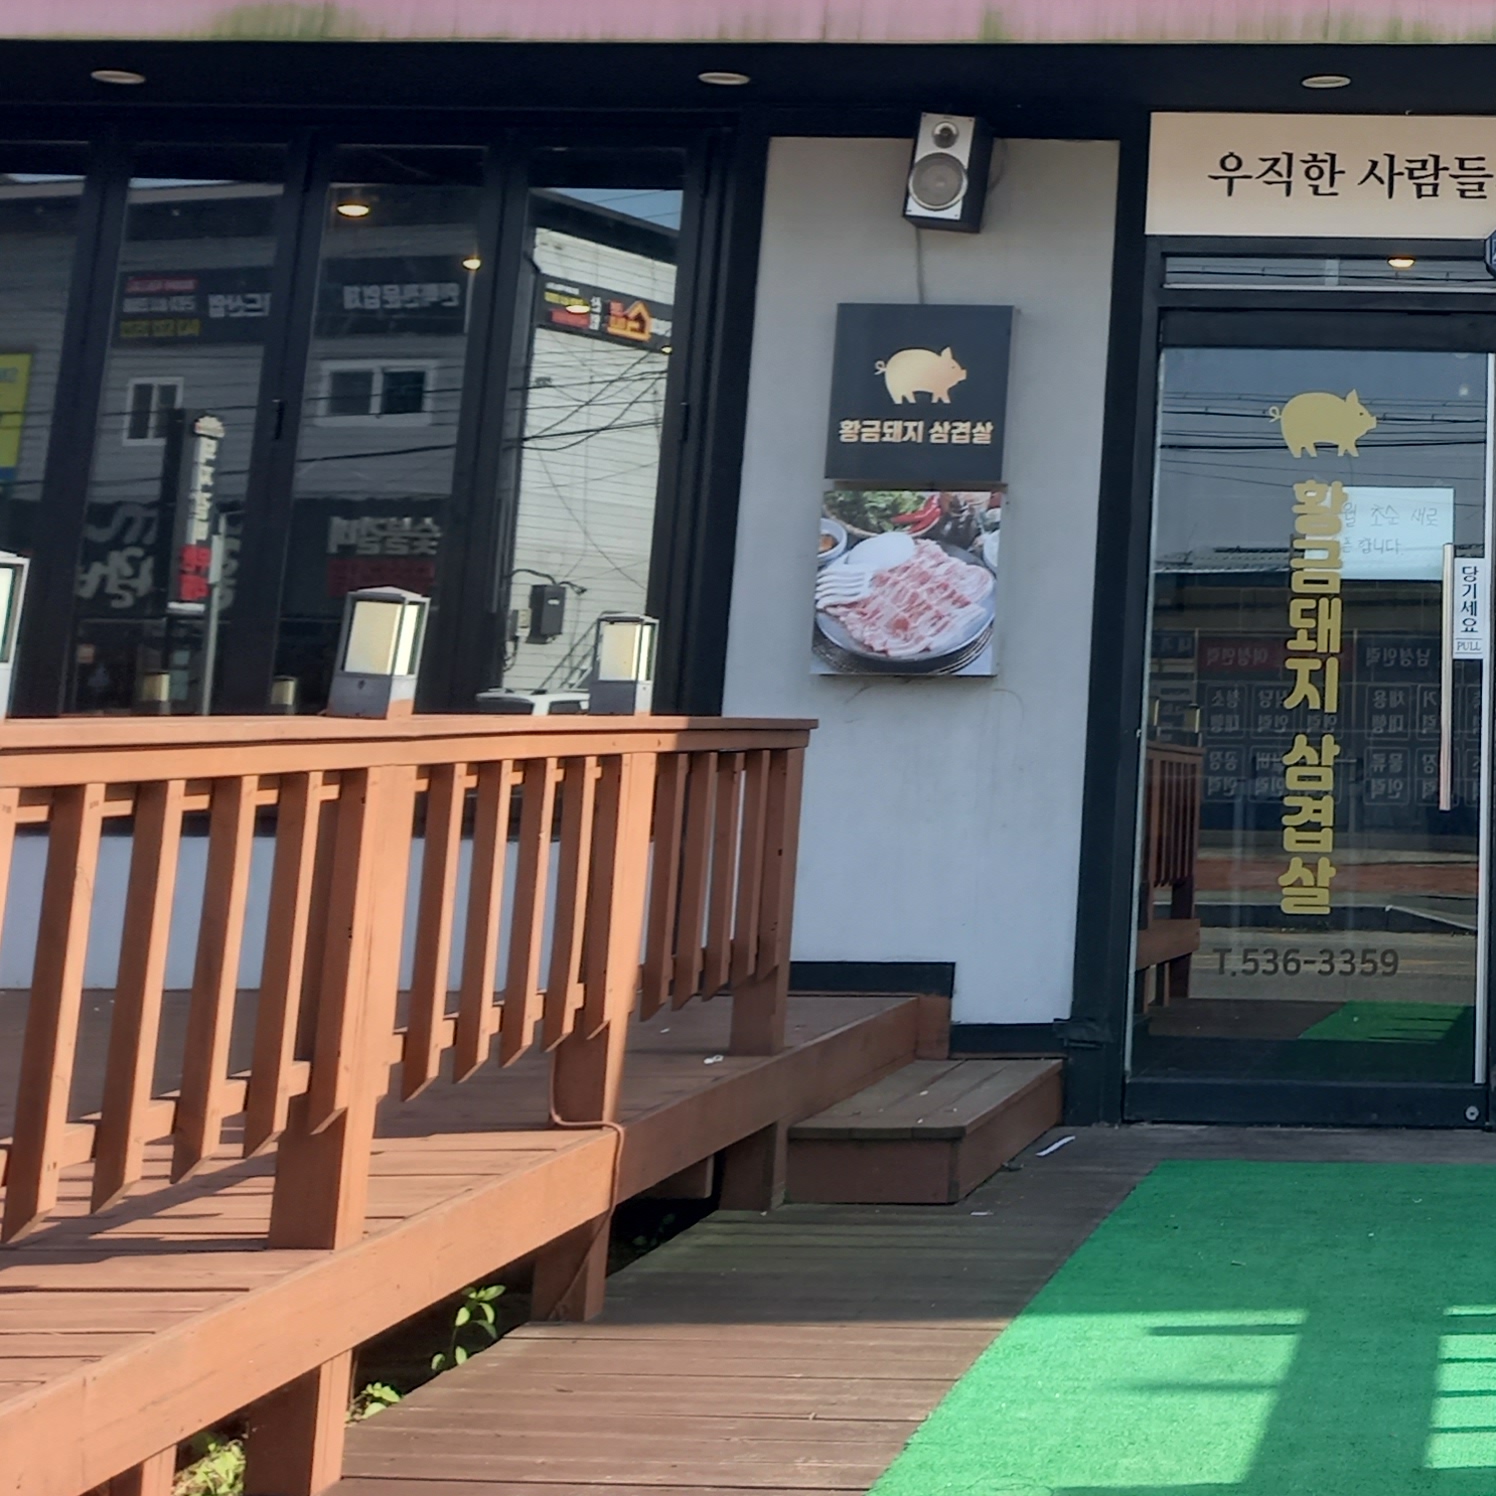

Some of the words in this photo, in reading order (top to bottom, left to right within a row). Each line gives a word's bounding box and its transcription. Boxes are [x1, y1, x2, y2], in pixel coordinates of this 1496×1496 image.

[1207, 151, 1346, 199] 우직한
[838, 419, 924, 444] 황금돼지
[929, 420, 994, 445] 삼겹살
[1281, 478, 1347, 715] 황금돼지
[1458, 564, 1481, 636] 당기세요
[1456, 639, 1482, 653] PULL
[1277, 734, 1342, 916] 삼겹살
[1213, 947, 1399, 977] T.536-3359
